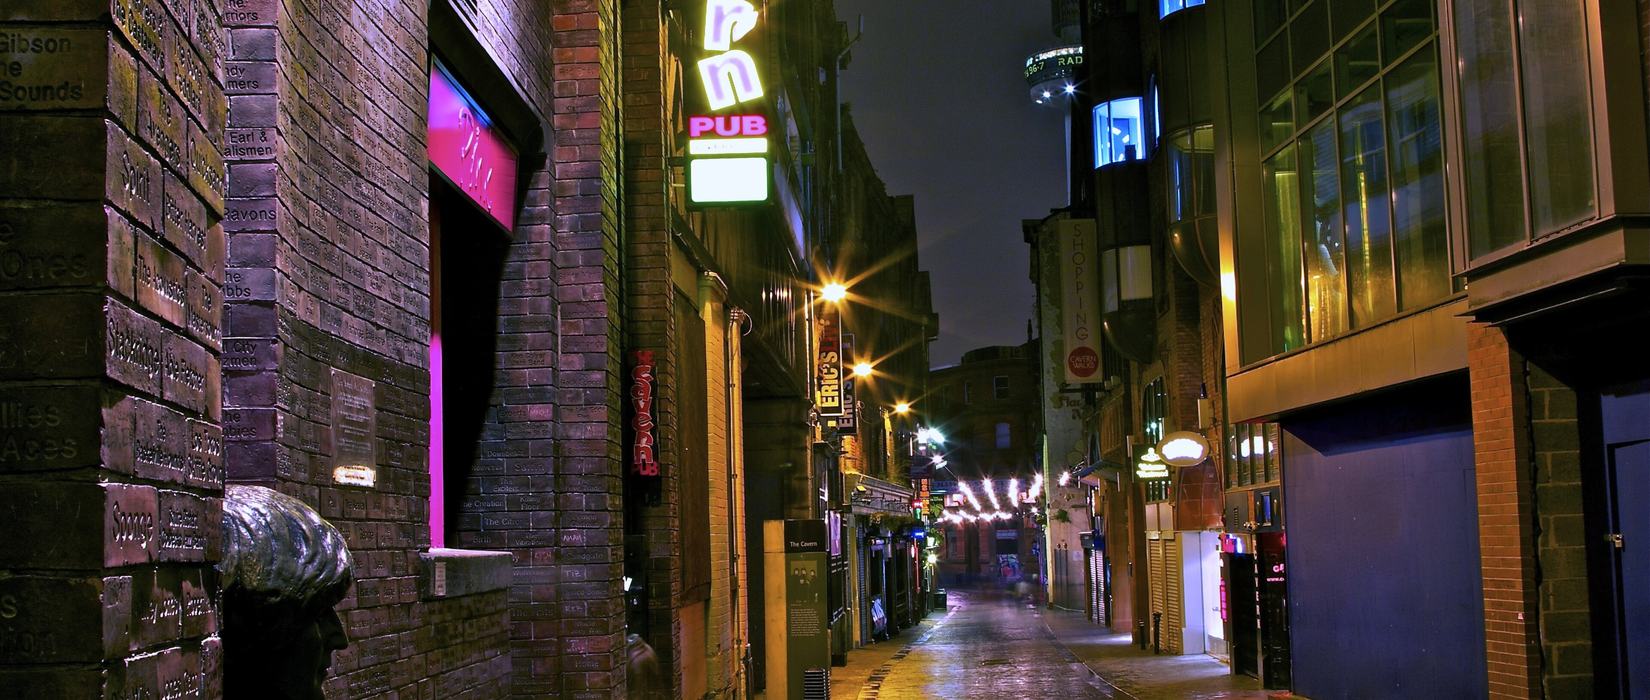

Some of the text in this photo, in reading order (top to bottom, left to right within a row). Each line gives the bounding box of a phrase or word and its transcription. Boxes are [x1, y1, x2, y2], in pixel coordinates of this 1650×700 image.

[229, 130, 268, 144] Earl &
[689, 115, 768, 138] PUB
[224, 146, 273, 157] alismen
[122, 150, 150, 205] Spirit
[1072, 223, 1090, 341] SHOPPING
[233, 341, 257, 356] City
[222, 356, 257, 368] zmen
[821, 351, 839, 408] ERIC'S
[112, 500, 154, 550] Sponge
